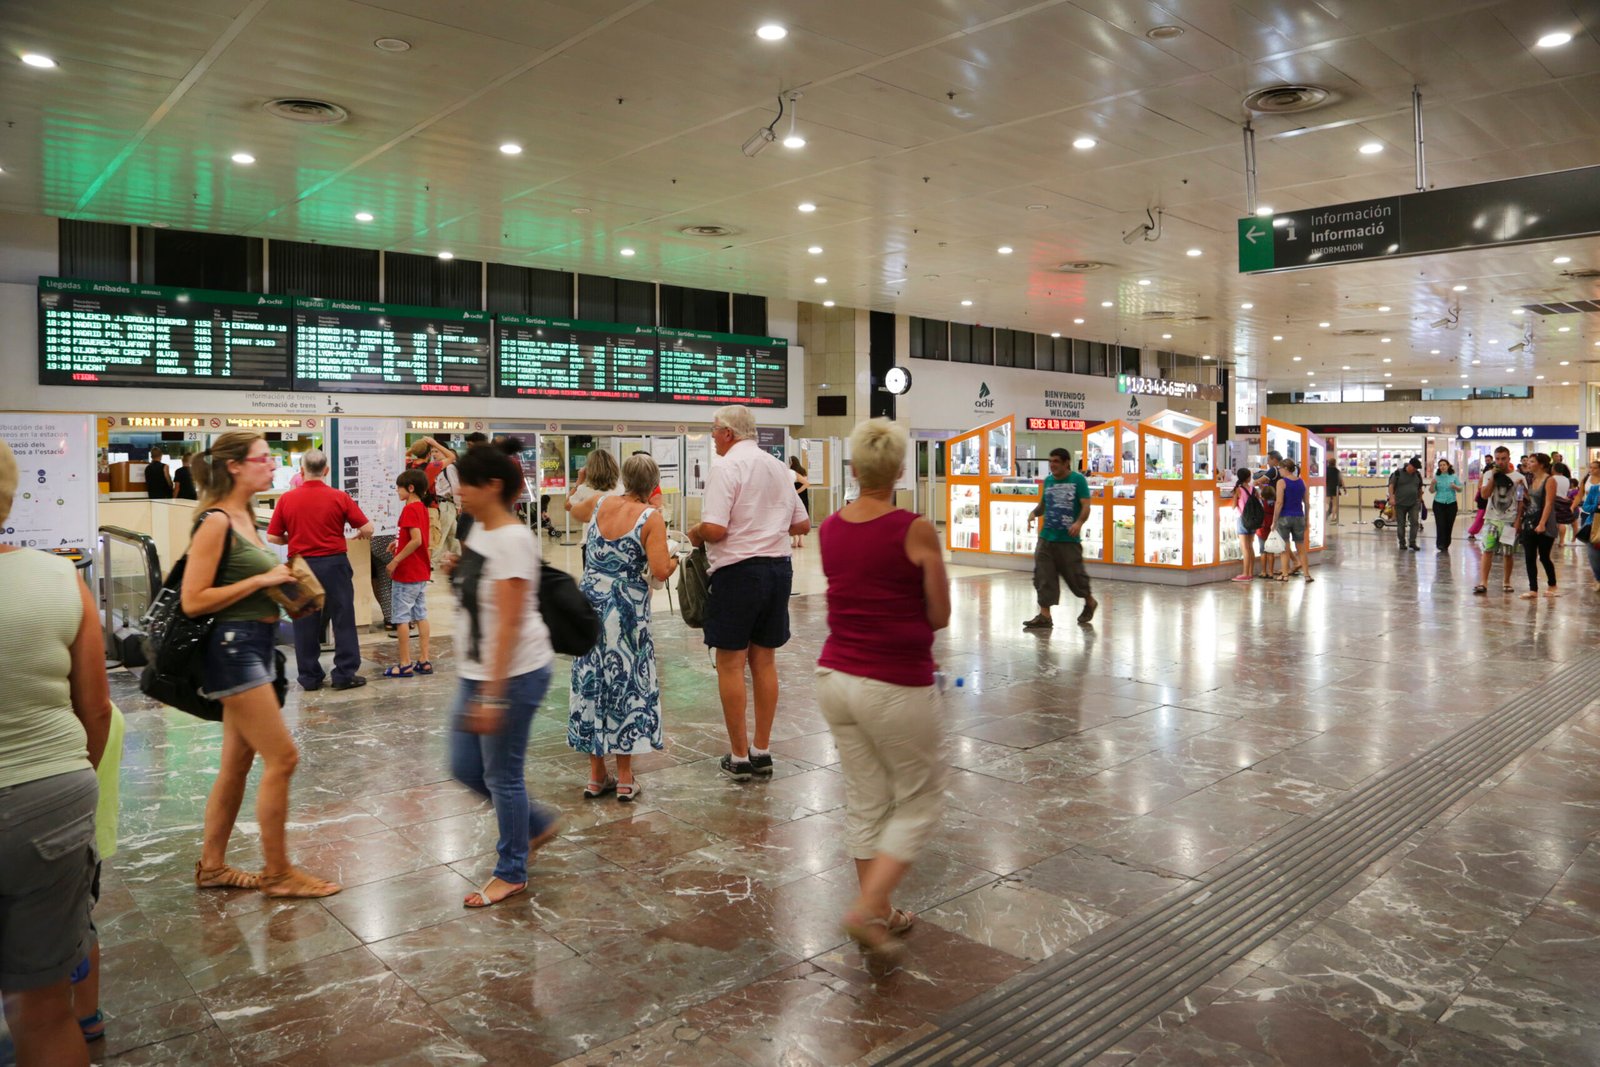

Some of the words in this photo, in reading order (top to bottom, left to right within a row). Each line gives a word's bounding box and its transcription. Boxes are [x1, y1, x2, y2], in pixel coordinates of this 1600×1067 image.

[1311, 204, 1392, 226] Información
[1311, 222, 1385, 243] Informació
[1311, 242, 1364, 255] INFORMATION
[46, 280, 81, 290] Llegadas
[93, 284, 130, 293] Arribades
[297, 300, 324, 308] Llegadas
[332, 302, 361, 310] Arribades
[46, 319, 70, 327] 18:30
[72, 321, 101, 329] MADRID
[127, 324, 154, 332] ATOCHA
[72, 312, 110, 321] VALENCIA
[156, 317, 187, 326] EUROMED
[194, 320, 211, 328] 1152
[221, 321, 230, 329] 12
[317, 327, 340, 335] MADRID
[46, 328, 70, 336] 18:40
[72, 329, 101, 338] MADRID
[127, 332, 154, 340] ATOCHA
[231, 338, 252, 346] AVANT
[46, 336, 71, 344] 18:45
[72, 338, 150, 348] FIGUERES-VILAFANT
[156, 342, 170, 350] AVE
[317, 342, 344, 350] SEVILLA
[46, 345, 71, 353] 18:50
[122, 349, 150, 357] CRESPO
[156, 350, 178, 358] ALVIA
[156, 358, 178, 366] AVANT
[73, 364, 106, 372] ALACANT
[156, 367, 187, 375] EUROMED
[1044, 390, 1085, 400] BIENVENIDOS
[974, 399, 995, 408] adif
[1045, 400, 1085, 409] BENVINGUTS
[1050, 409, 1080, 418] WELCOME
[1127, 408, 1141, 416] adif
[128, 417, 165, 427] TRAIN
[170, 418, 199, 427] INFO
[411, 421, 438, 429] TRAIN
[443, 421, 465, 429] INFO
[188, 432, 197, 440] 23
[285, 432, 294, 440] 24
[1477, 428, 1517, 437] SANIFAIR
